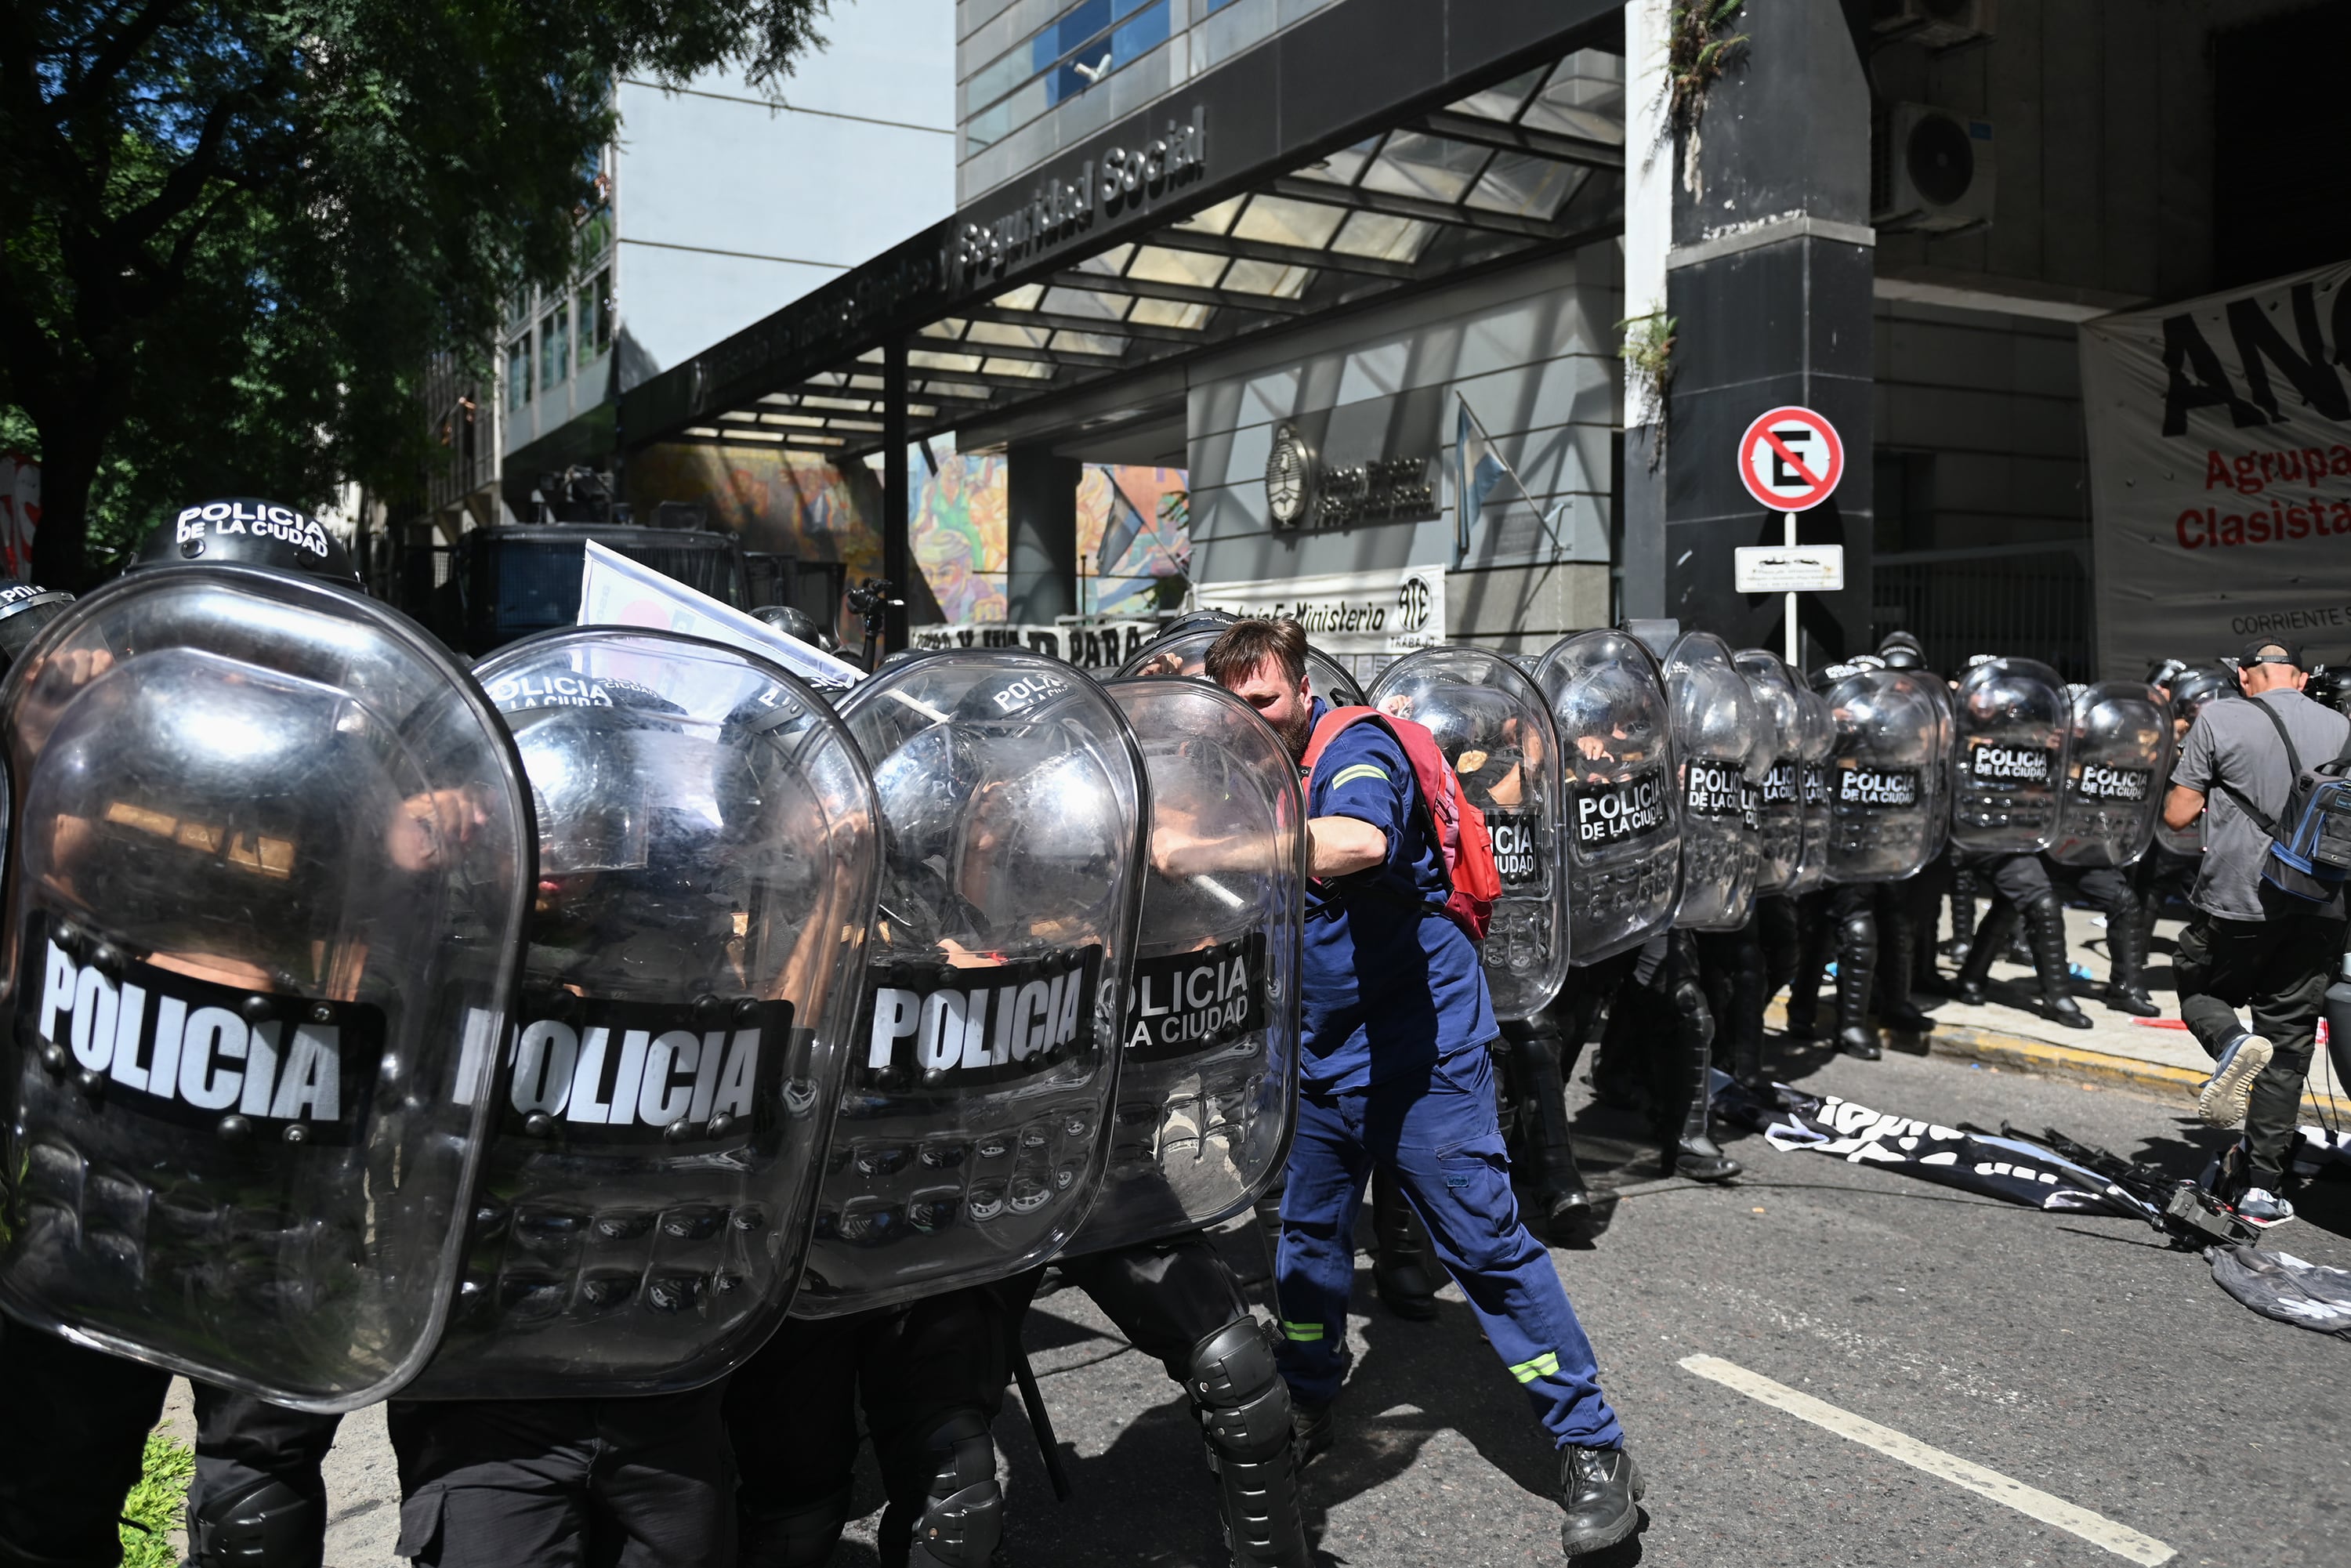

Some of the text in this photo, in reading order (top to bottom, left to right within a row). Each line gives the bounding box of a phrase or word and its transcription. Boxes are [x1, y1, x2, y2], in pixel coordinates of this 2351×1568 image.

[1099, 105, 1207, 202] Social
[176, 502, 328, 545] POLICIA
[176, 520, 329, 558] DE LA CIUDAD
[2176, 497, 2351, 550] Clasista
[1295, 600, 1386, 633] Ministerio
[1399, 578, 1429, 628] ATE
[2232, 607, 2343, 636] CORRIENTE
[1390, 636, 1436, 649] TRABAJO
[488, 676, 613, 708] OLICIA
[1975, 762, 2048, 778] DE LA CIUDAD
[1976, 747, 2047, 768] POLICIA
[1842, 771, 1915, 793] POLICIA
[2081, 780, 2099, 794] DE
[2100, 784, 2115, 796] LA
[2082, 766, 2147, 788] POLICIA
[1578, 777, 1662, 824] POLICIA
[1689, 791, 1708, 807] DE
[1711, 793, 1726, 808] LA
[1840, 788, 1860, 802] DE
[1861, 790, 1879, 802] LA
[1487, 825, 1534, 855] ICIA
[1580, 820, 1606, 841] DE
[1609, 816, 1630, 835] LA
[39, 938, 341, 1122] POLICIA
[868, 968, 1083, 1070] POLICIA
[1161, 994, 1249, 1044] CIUDAD
